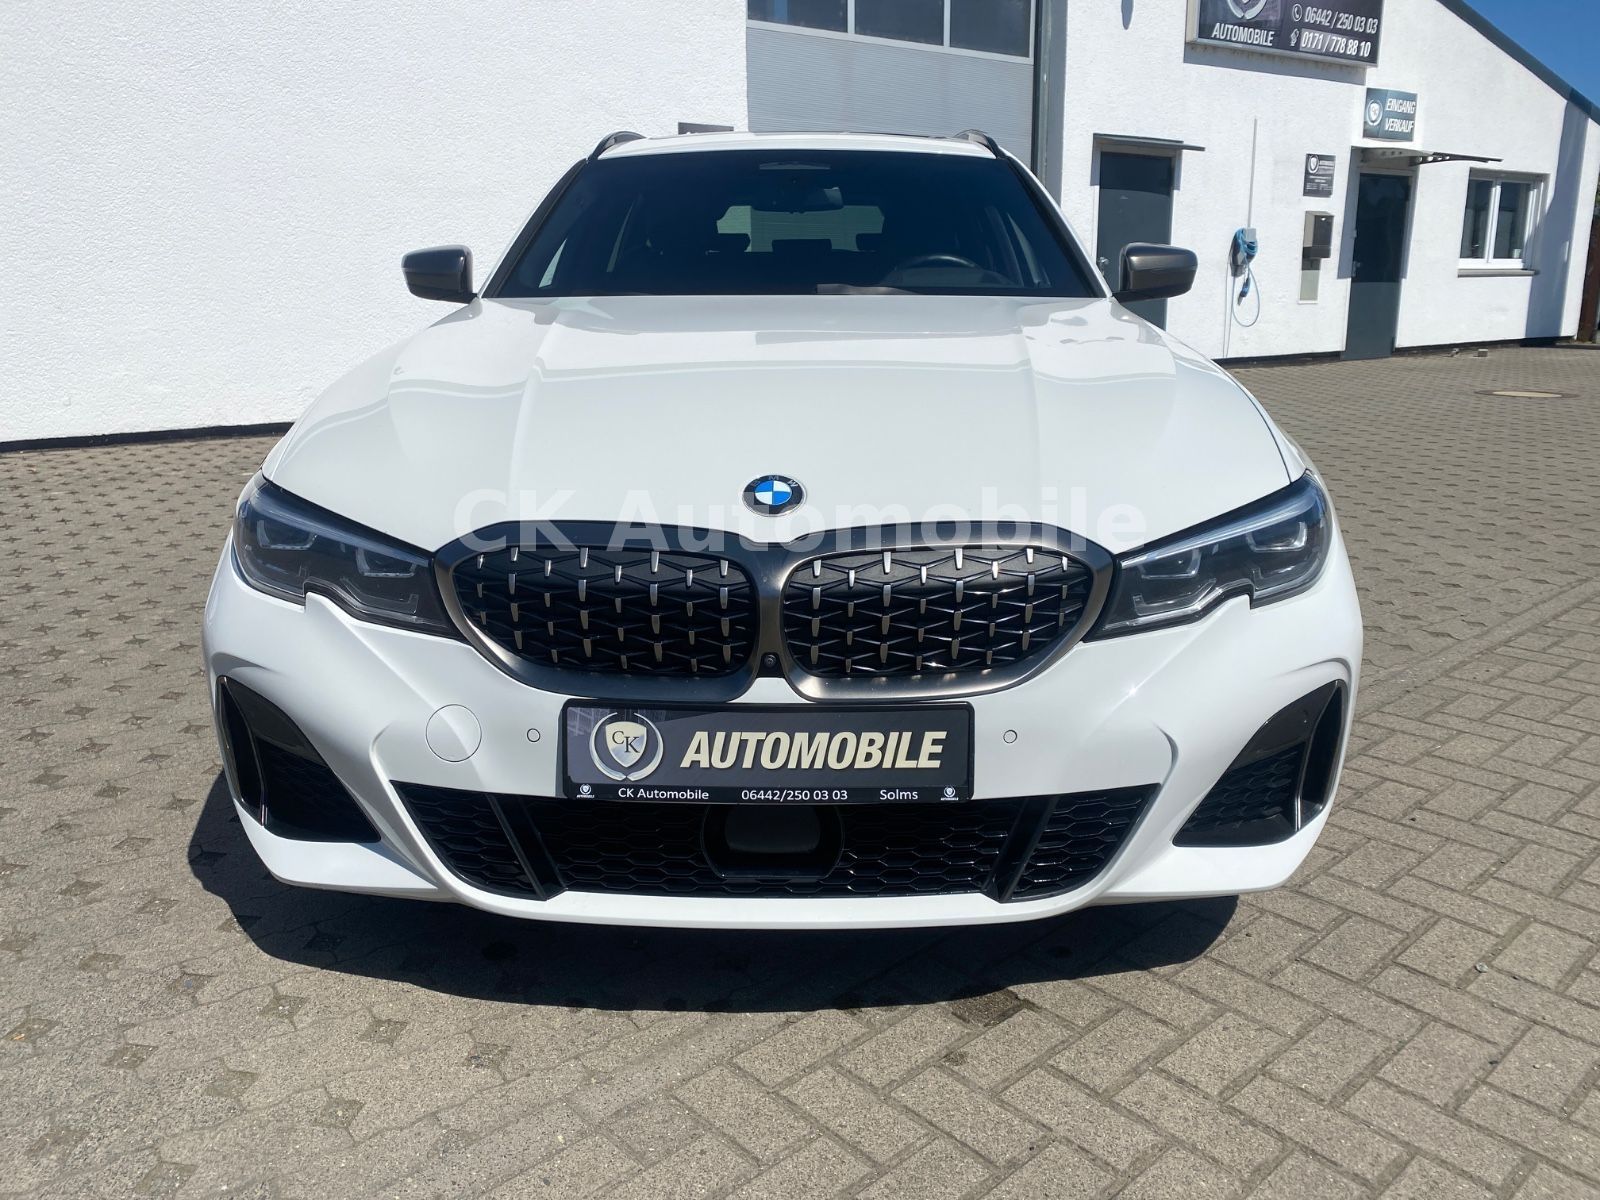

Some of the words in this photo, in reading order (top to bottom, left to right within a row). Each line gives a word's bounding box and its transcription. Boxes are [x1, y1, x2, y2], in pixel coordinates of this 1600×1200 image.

[1304, 6, 1332, 26] 06442
[1336, 12, 1354, 30] 250
[1354, 15, 1366, 32] 03
[1366, 17, 1379, 34] 03
[1211, 22, 1275, 46] AUTOMOBILE
[1301, 31, 1324, 50] 0171
[1329, 36, 1347, 54] 778
[1346, 39, 1359, 56] 88
[1359, 41, 1372, 57] 10
[1386, 98, 1417, 114] EINGANG
[1384, 117, 1415, 133] VERKAUF
[612, 730, 641, 753] CK
[680, 730, 948, 770] AUTOMOBILE
[618, 787, 634, 798] CK
[637, 788, 709, 800] Automobile
[741, 789, 810, 802] 06442/250
[813, 790, 829, 801] 03
[832, 790, 848, 801] 03
[879, 789, 919, 800] Solms
